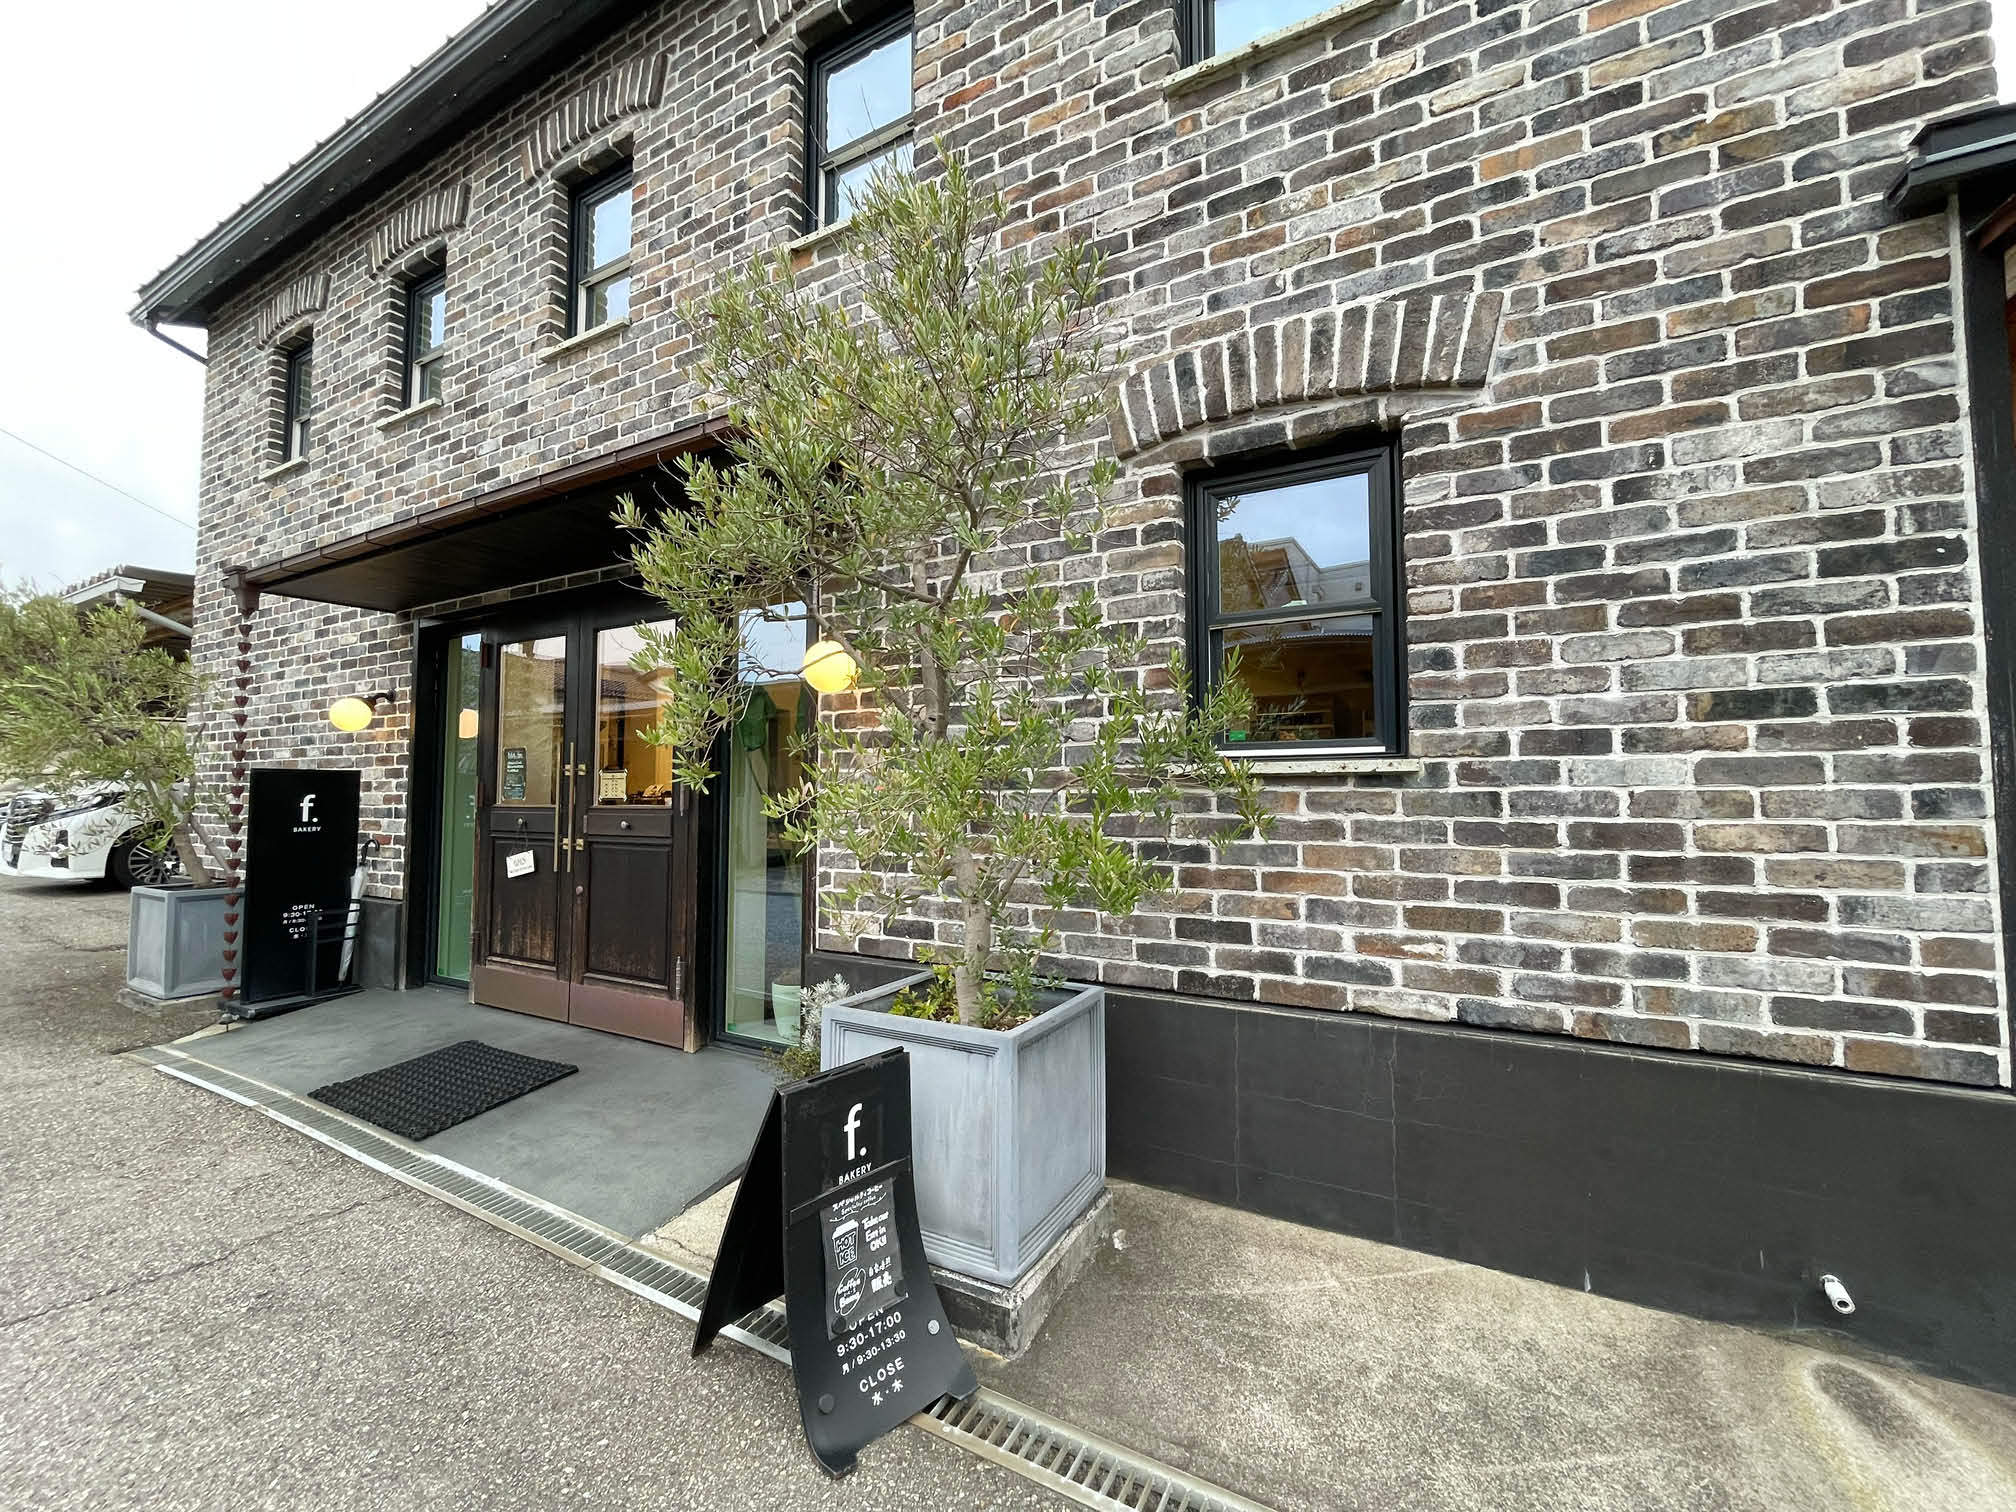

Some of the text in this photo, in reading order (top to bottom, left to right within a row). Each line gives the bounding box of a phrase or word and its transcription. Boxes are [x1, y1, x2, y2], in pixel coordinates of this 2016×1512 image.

[300, 793, 318, 822] f.
[293, 825, 321, 833] BAKERY
[292, 903, 315, 911] OPEN
[843, 1102, 867, 1161] f.
[838, 1162, 872, 1185] BAKERY
[835, 1231, 856, 1253] HOT
[836, 1311, 902, 1357] 9:30-17:00
[859, 1357, 905, 1393] CLOSE
